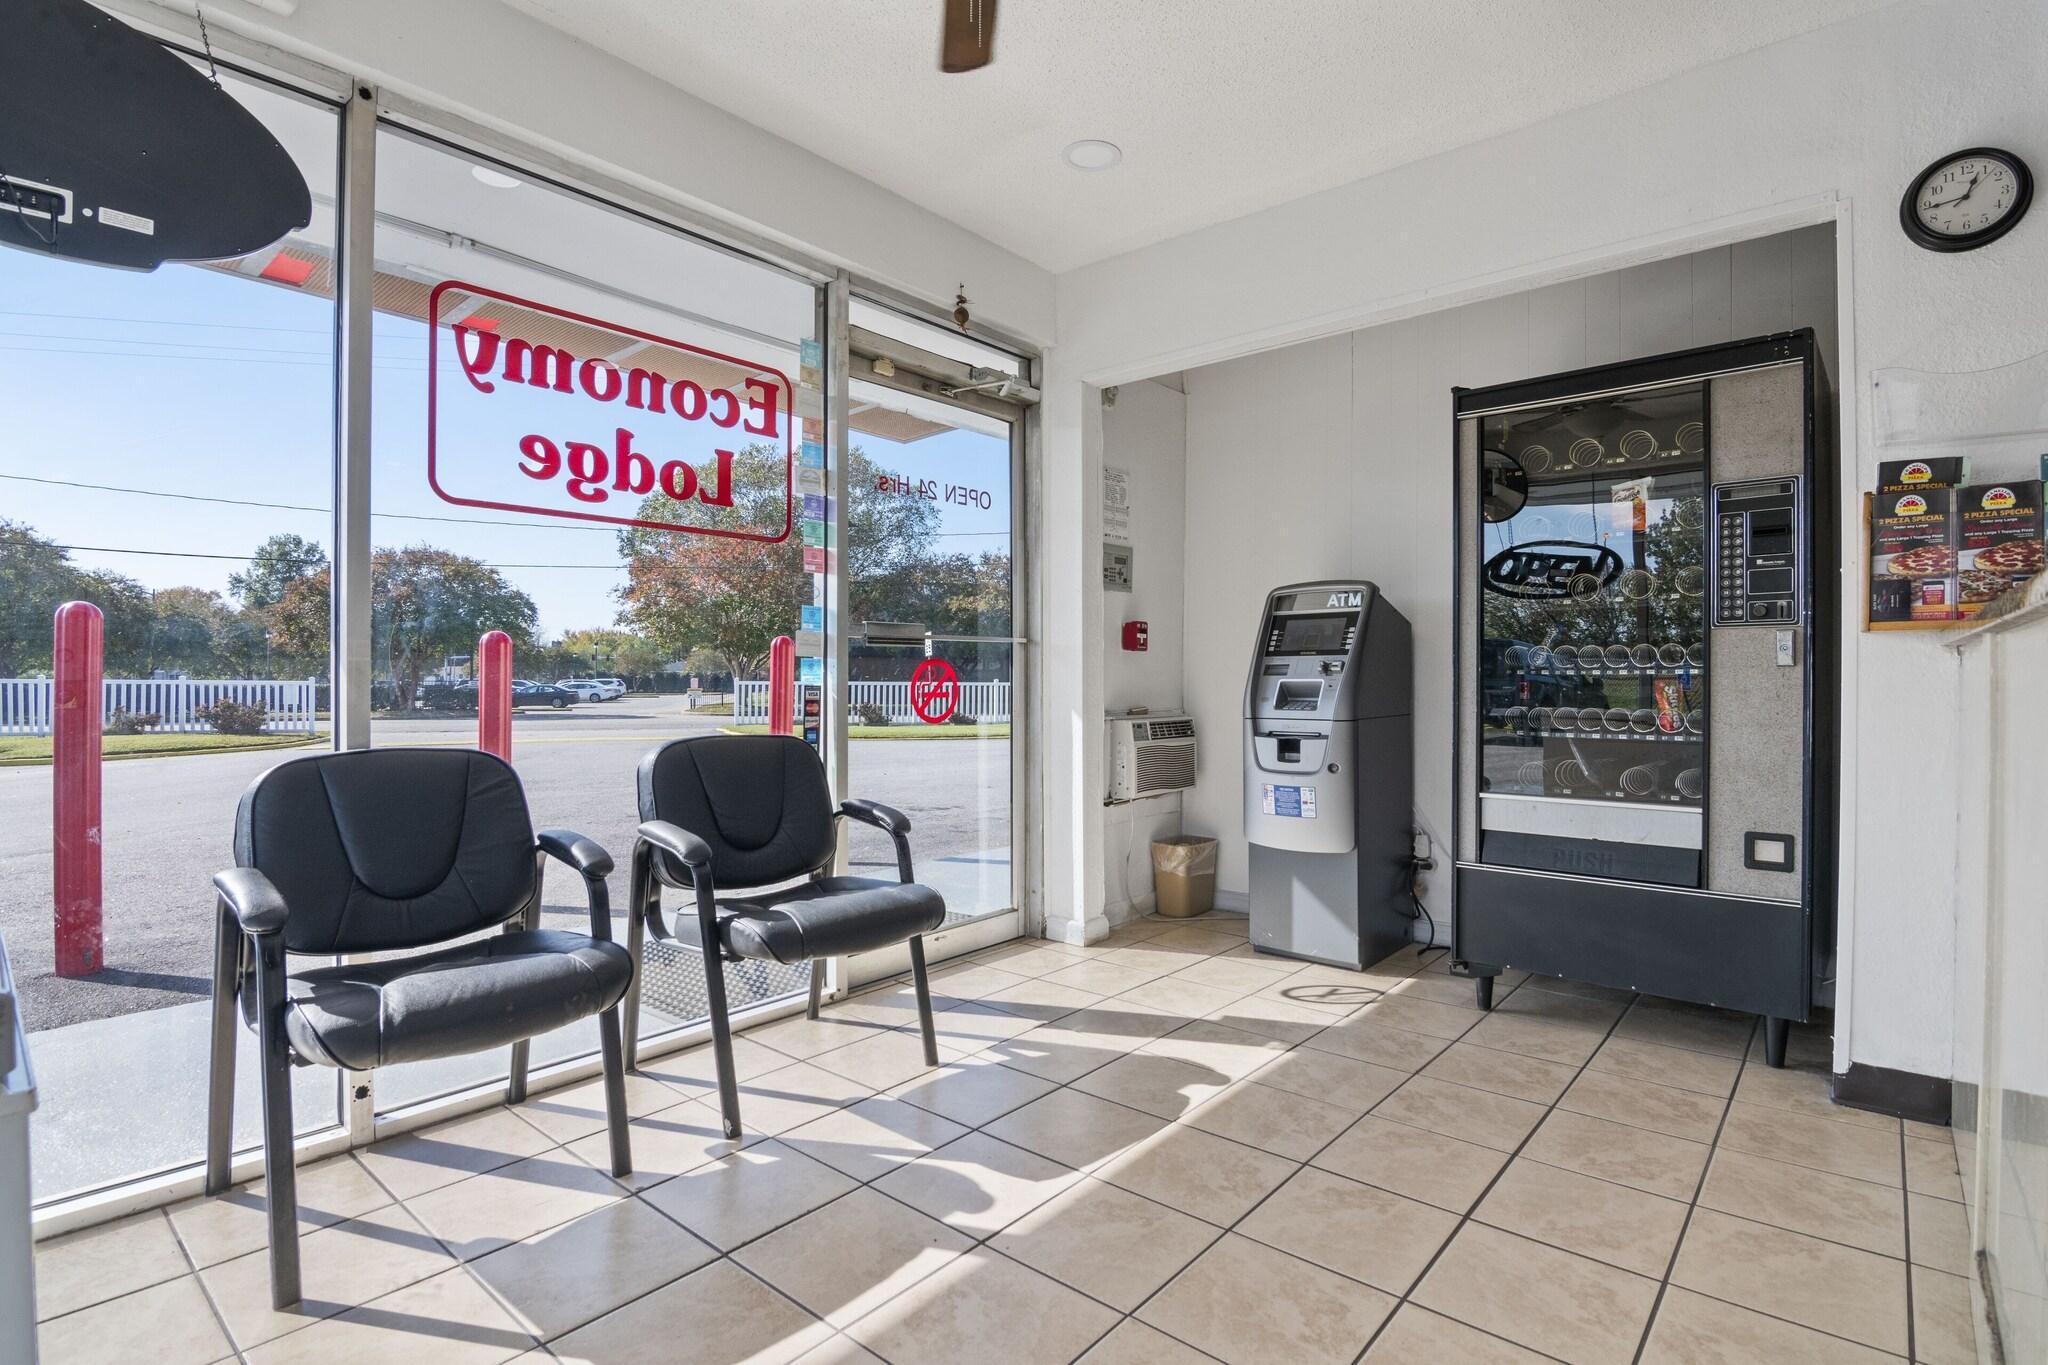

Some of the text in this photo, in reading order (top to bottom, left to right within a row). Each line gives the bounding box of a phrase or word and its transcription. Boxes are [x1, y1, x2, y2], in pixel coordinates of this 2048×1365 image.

[1960, 164, 1974, 175] 12
[1983, 165, 1987, 174] 1
[1944, 172, 1955, 183] 11
[1994, 171, 2003, 181] 2
[1931, 185, 1943, 196] 10
[2001, 185, 2010, 194] 3
[1923, 201, 1932, 210] 9
[1994, 199, 2002, 209] 4
[1930, 214, 1938, 223] 8
[1980, 214, 1989, 224] 5
[1944, 220, 1952, 230] 7
[1963, 220, 1970, 230] 6
[1916, 482, 1948, 490] SPECIAL
[1971, 510, 1997, 518] PIZZA
[2000, 507, 2035, 516] SPECIAL
[1885, 516, 1911, 524] PIZZA
[1912, 514, 1945, 522] SPECIAL
[1326, 591, 1362, 608] ATM
